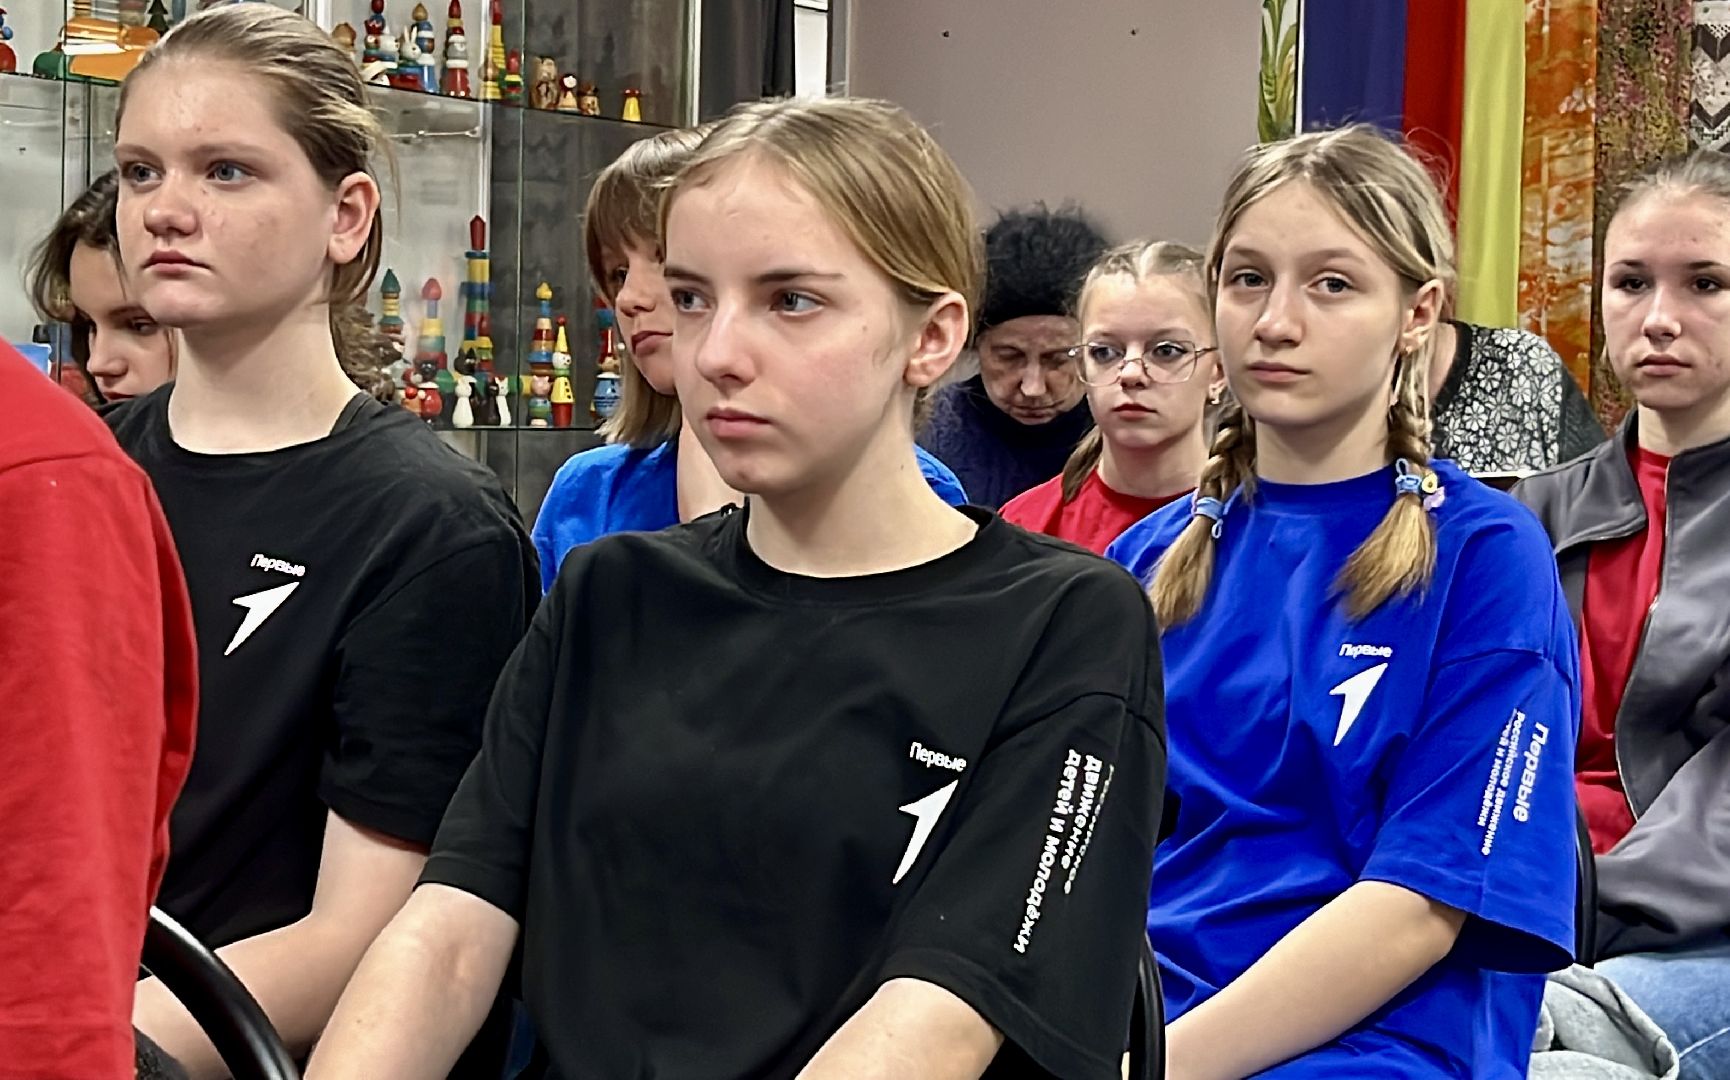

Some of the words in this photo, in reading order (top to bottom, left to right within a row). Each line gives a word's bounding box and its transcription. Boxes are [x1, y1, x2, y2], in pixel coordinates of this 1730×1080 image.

[250, 553, 306, 577] Первые
[1338, 643, 1393, 660] Первые
[909, 741, 967, 773] Первые
[1053, 749, 1081, 814] детей
[1495, 747, 1506, 757] и
[1500, 711, 1526, 788] Российское
[1512, 721, 1549, 822] Первые
[1049, 817, 1065, 833] и
[1061, 754, 1103, 869] движение
[1481, 787, 1506, 856] движение
[1014, 835, 1060, 954] молодёжи
